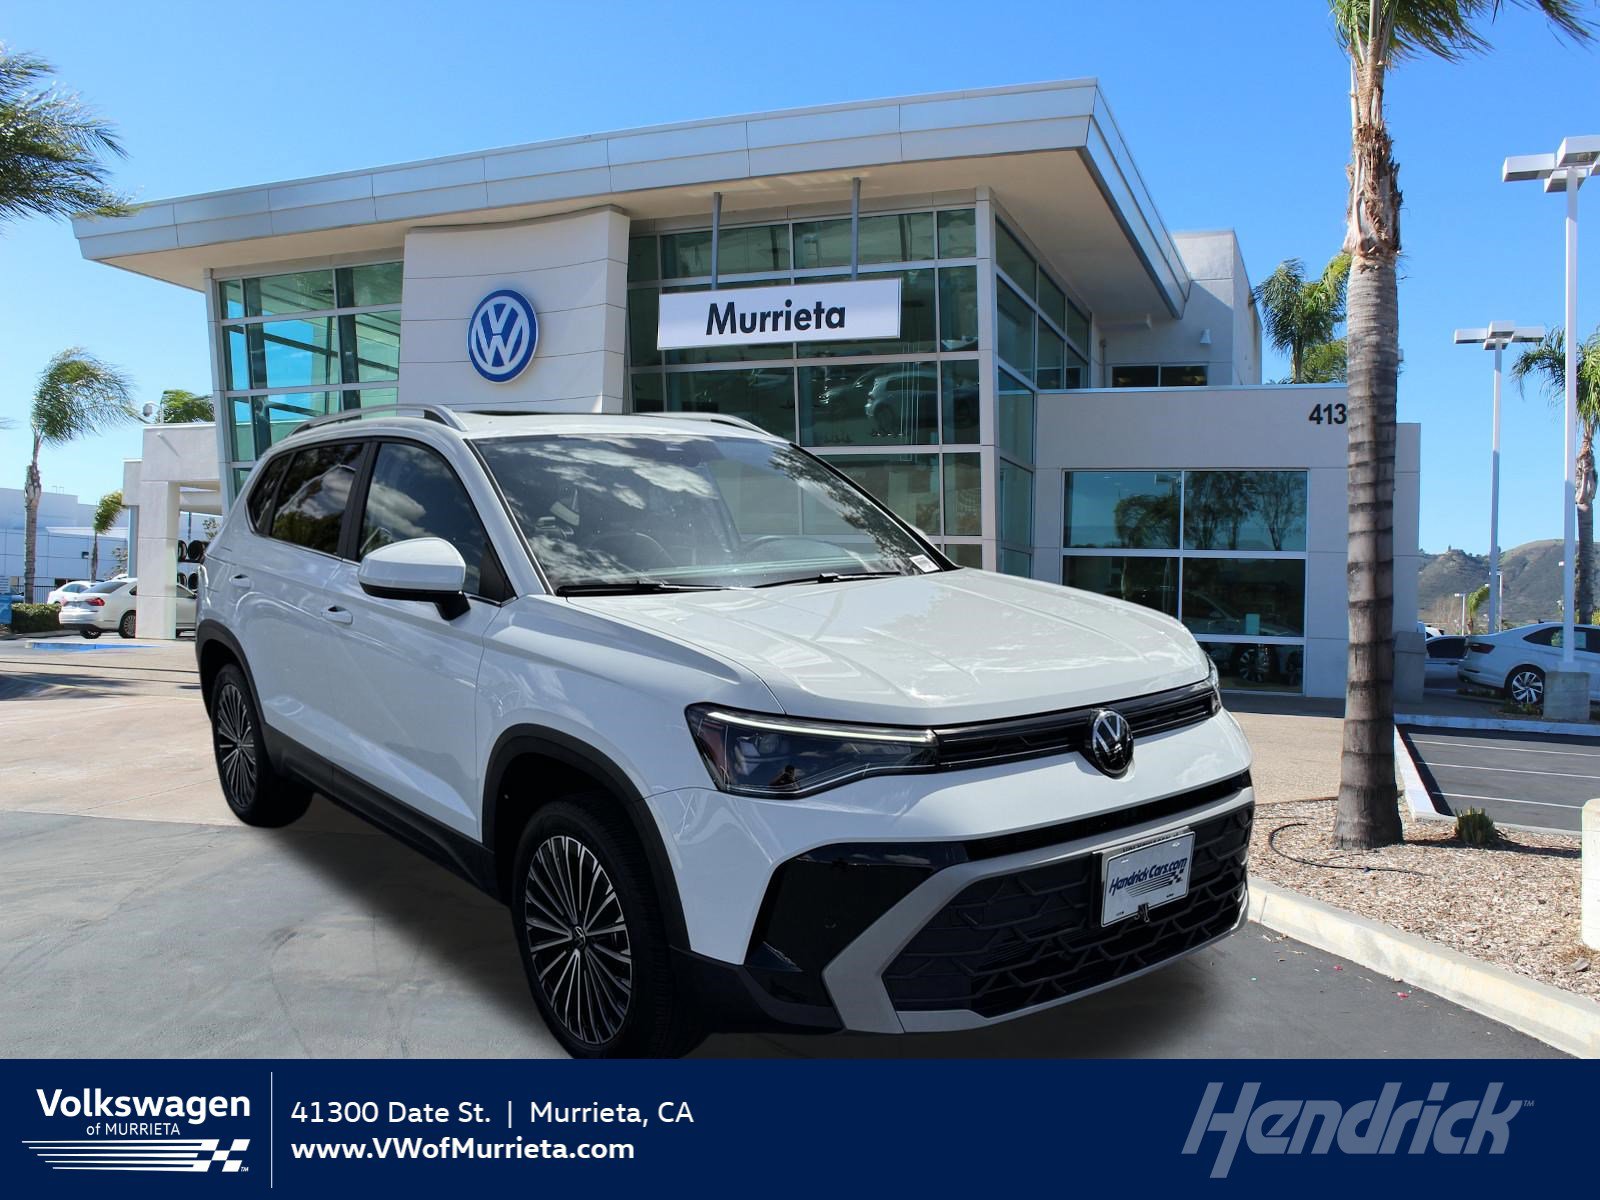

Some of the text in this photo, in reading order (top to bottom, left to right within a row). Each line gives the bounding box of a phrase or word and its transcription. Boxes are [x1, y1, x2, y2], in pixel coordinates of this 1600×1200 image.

[706, 299, 846, 336] Murrieta
[469, 294, 535, 380] VW
[1309, 403, 1347, 425] 413
